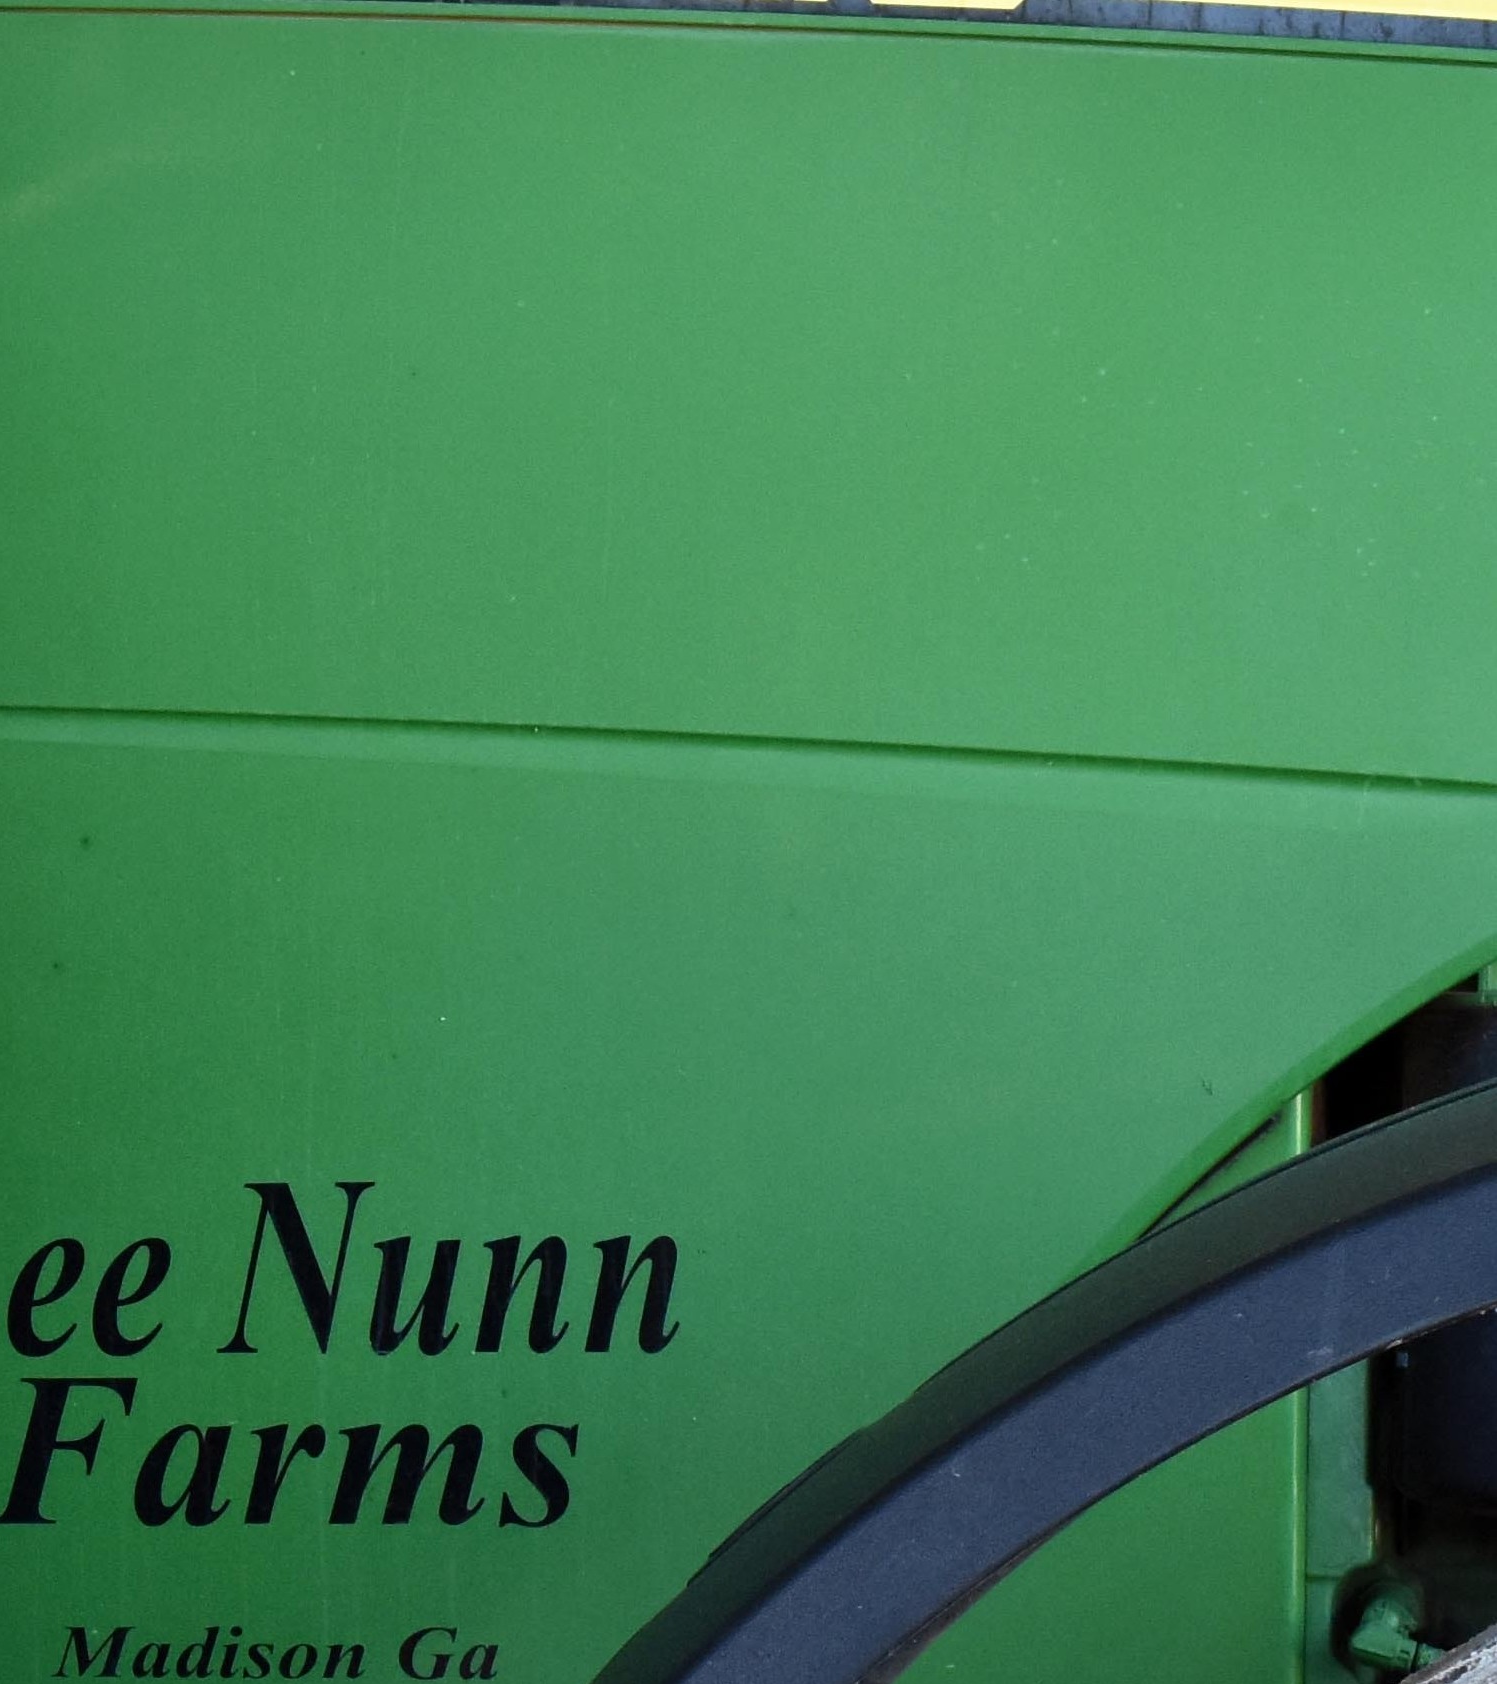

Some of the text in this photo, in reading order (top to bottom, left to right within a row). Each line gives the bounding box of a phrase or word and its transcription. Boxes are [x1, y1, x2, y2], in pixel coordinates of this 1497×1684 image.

[216, 1181, 680, 1357] Nunn
[50, 1625, 500, 1681] Madison Ga
